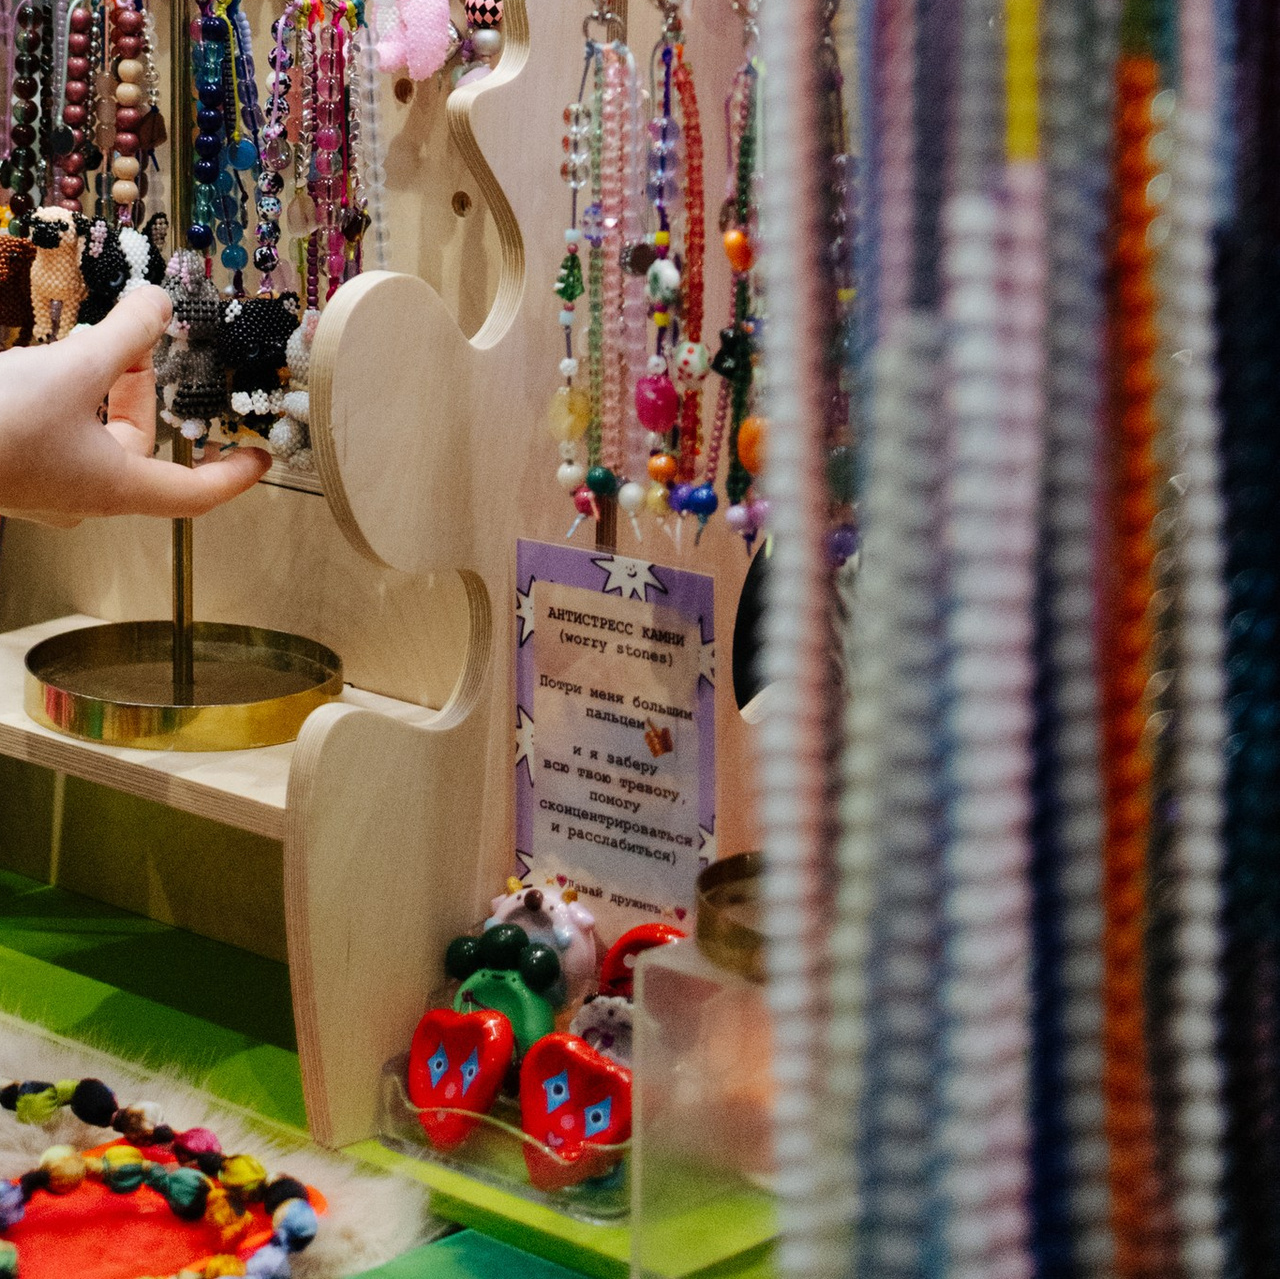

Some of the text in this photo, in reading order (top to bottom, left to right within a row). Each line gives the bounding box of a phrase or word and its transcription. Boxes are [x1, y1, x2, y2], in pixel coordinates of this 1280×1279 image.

[548, 607, 686, 647] АНТИСТРЕСС КАМНИ
[560, 629, 673, 667] (worry stones)
[540, 674, 693, 721] Потри меня большим
[585, 708, 645, 731] пальцем
[573, 745, 658, 776] и я заберу
[543, 759, 686, 805] всю твою тревогу,
[589, 791, 641, 813] помогу
[539, 799, 693, 848] сконцентрироваться
[551, 822, 676, 866] и расслабиться)
[610, 893, 661, 914] дружить
